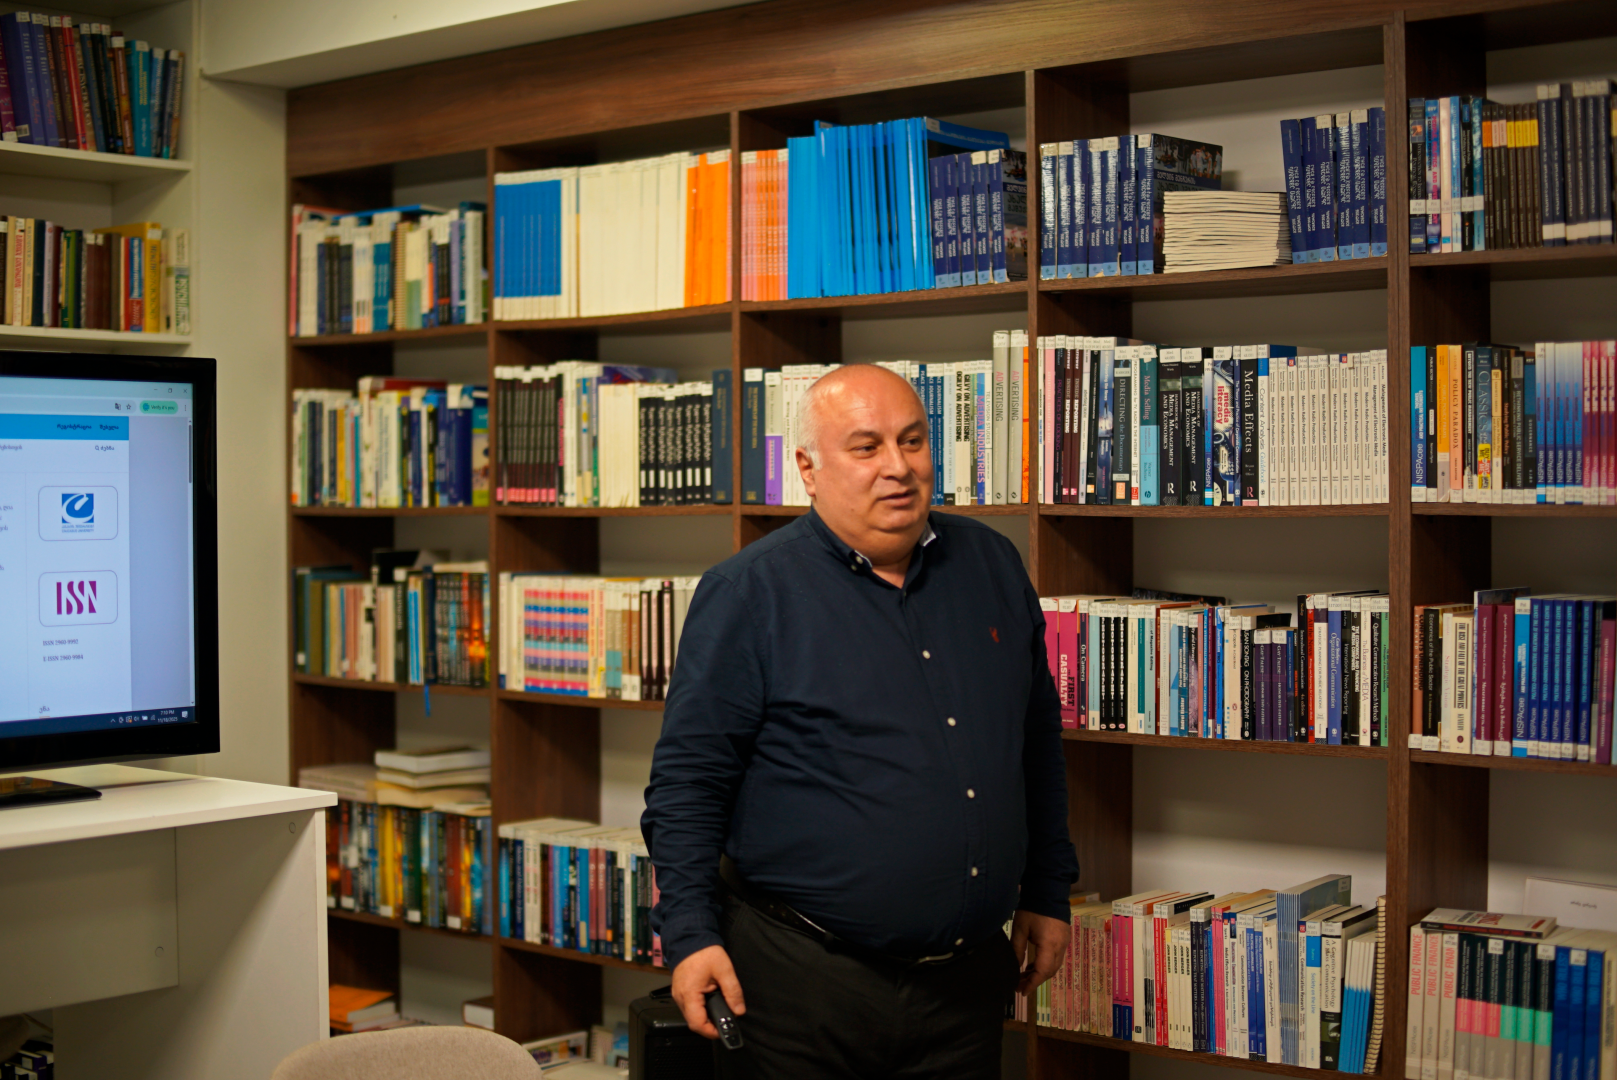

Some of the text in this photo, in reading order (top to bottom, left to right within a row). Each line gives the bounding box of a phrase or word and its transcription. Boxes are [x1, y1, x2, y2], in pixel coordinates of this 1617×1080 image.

[955, 392, 962, 400] ON
[963, 392, 970, 400] ON
[995, 371, 1004, 422] ADVERTISING
[1011, 370, 1020, 421] ADVERTISING
[1216, 386, 1224, 424] literacy
[1244, 370, 1254, 453] Media Effects
[1478, 371, 1490, 431] CLASSICS
[977, 394, 985, 484] MEDIA INDUSTRIES
[56, 580, 97, 615] ISSN
[1081, 644, 1086, 654] On
[1244, 670, 1249, 680] ON
[1411, 934, 1421, 995] PUBLIC FINANCE
[1427, 934, 1438, 996] PUBLIC FINANCE
[1444, 948, 1454, 998] PUBLIC FINAN
